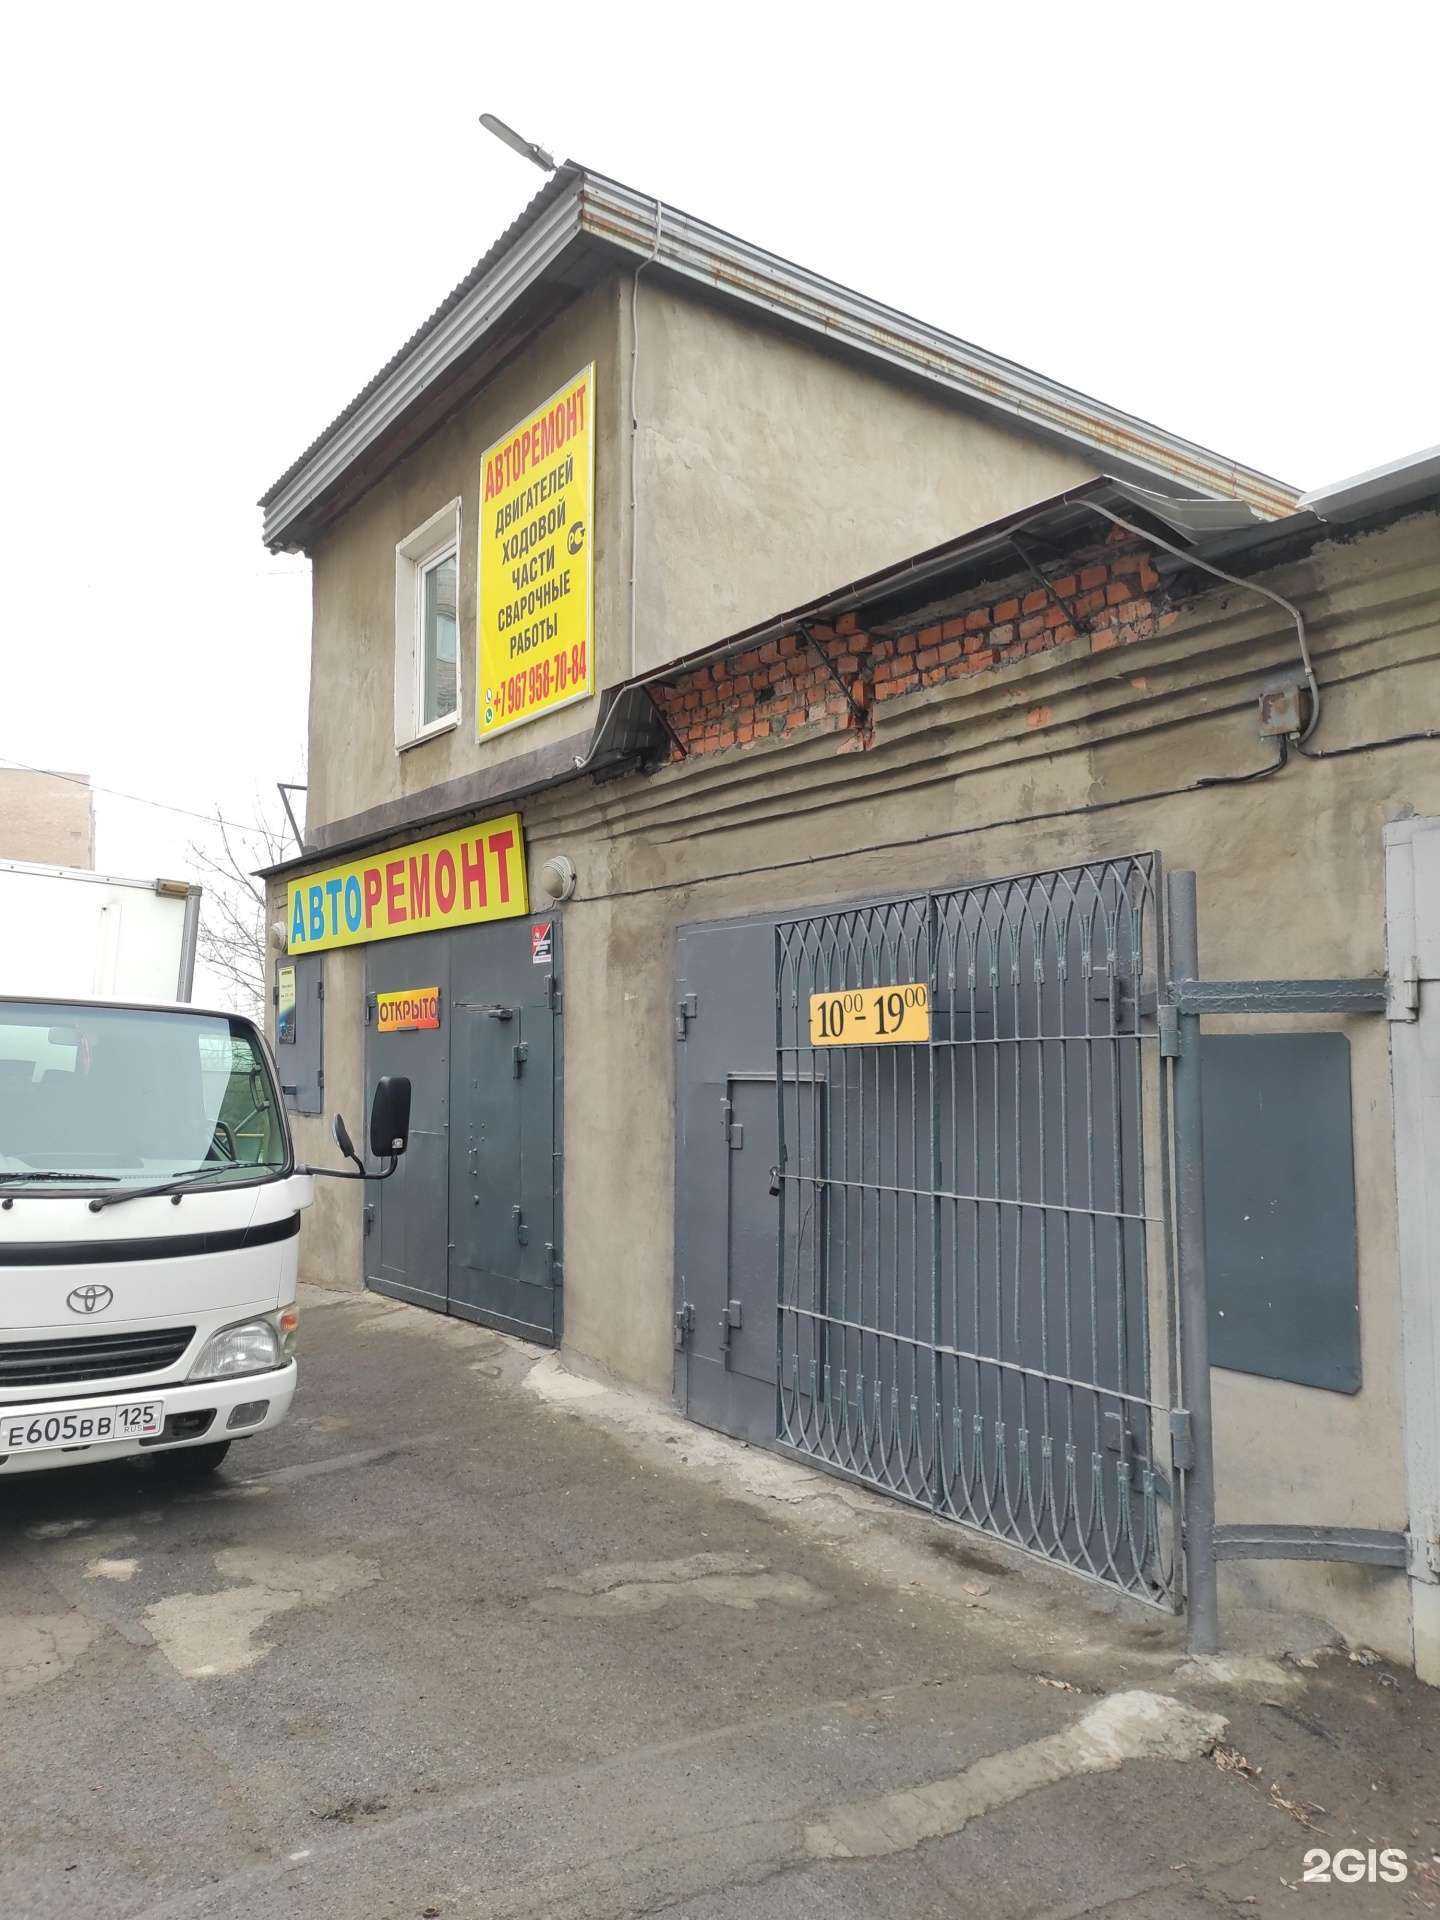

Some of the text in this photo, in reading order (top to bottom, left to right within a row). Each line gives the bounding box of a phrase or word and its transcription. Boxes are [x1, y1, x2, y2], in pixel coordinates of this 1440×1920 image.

[485, 384, 586, 502] АВТОРЕМОНТ
[495, 454, 574, 538] ДВИГАТЕЛЕЙ
[502, 496, 566, 565] ХОДОВОЙ
[512, 545, 555, 590] ЧАСТИ
[498, 569, 571, 632] СВАРОЧНЫЕ
[510, 612, 558, 659] РАБОТЫ
[291, 830, 514, 944] АВТОРЕМОНТ
[379, 996, 438, 1023] ОТКРЫТО
[119, 1406, 155, 1427] 125
[123, 1424, 143, 1433] RUS
